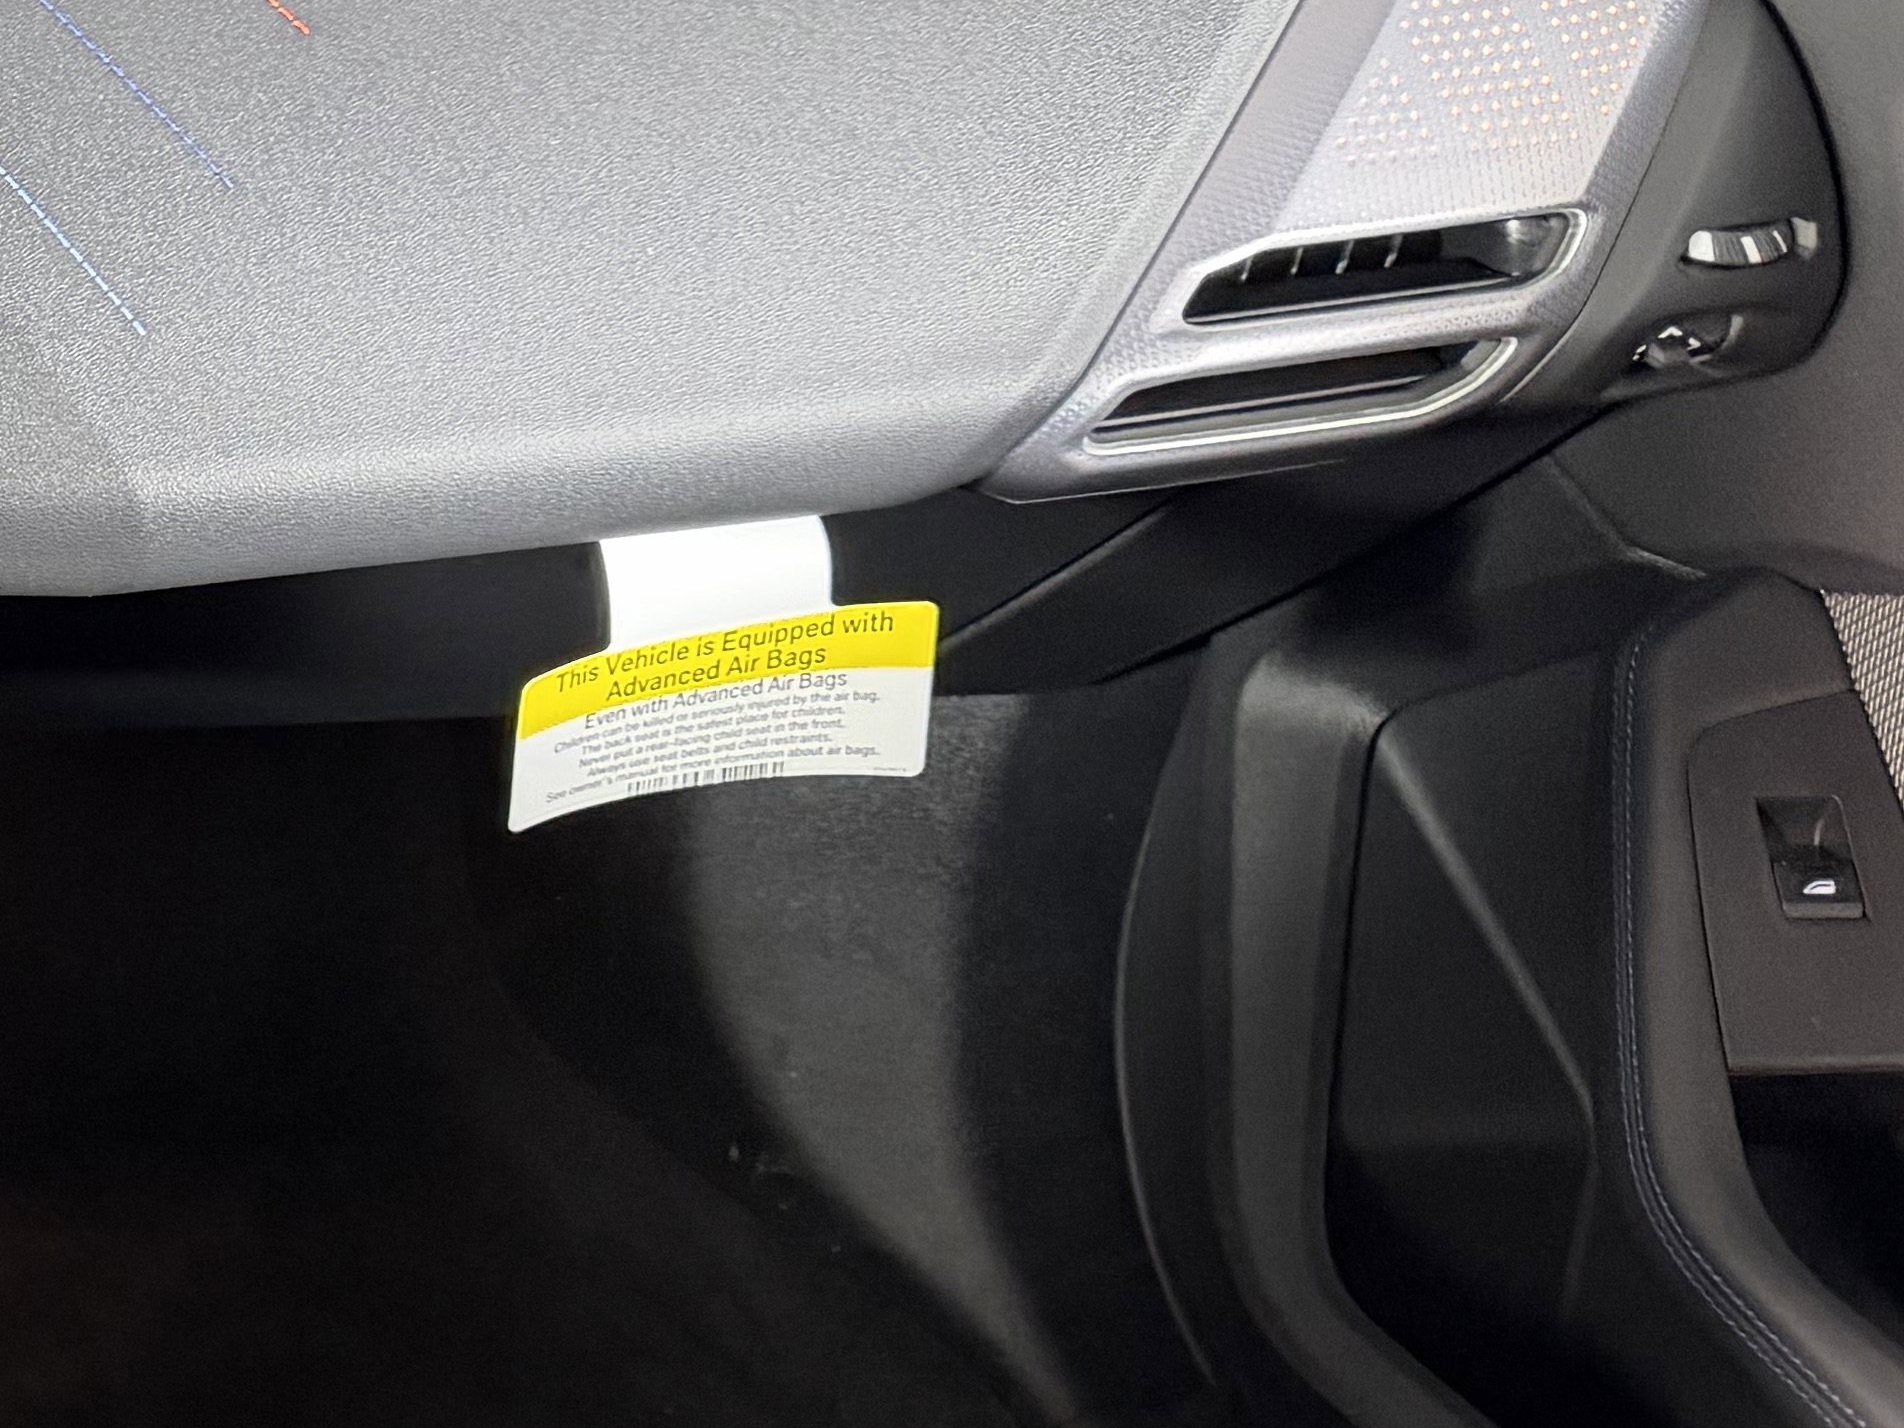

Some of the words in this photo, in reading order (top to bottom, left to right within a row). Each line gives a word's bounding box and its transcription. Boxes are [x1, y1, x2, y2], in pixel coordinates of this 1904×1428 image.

[556, 665, 599, 694] This
[605, 640, 690, 674] Vehicle
[696, 636, 714, 658] is
[721, 615, 835, 652] Equipped
[842, 609, 894, 634] with
[605, 659, 721, 702] Advanced
[726, 653, 761, 677] Air
[765, 645, 827, 673] Bags
[584, 705, 627, 730] Even
[631, 693, 669, 718] with
[672, 677, 764, 709] Advanced
[767, 674, 796, 694] Air
[798, 671, 848, 691] Bags
